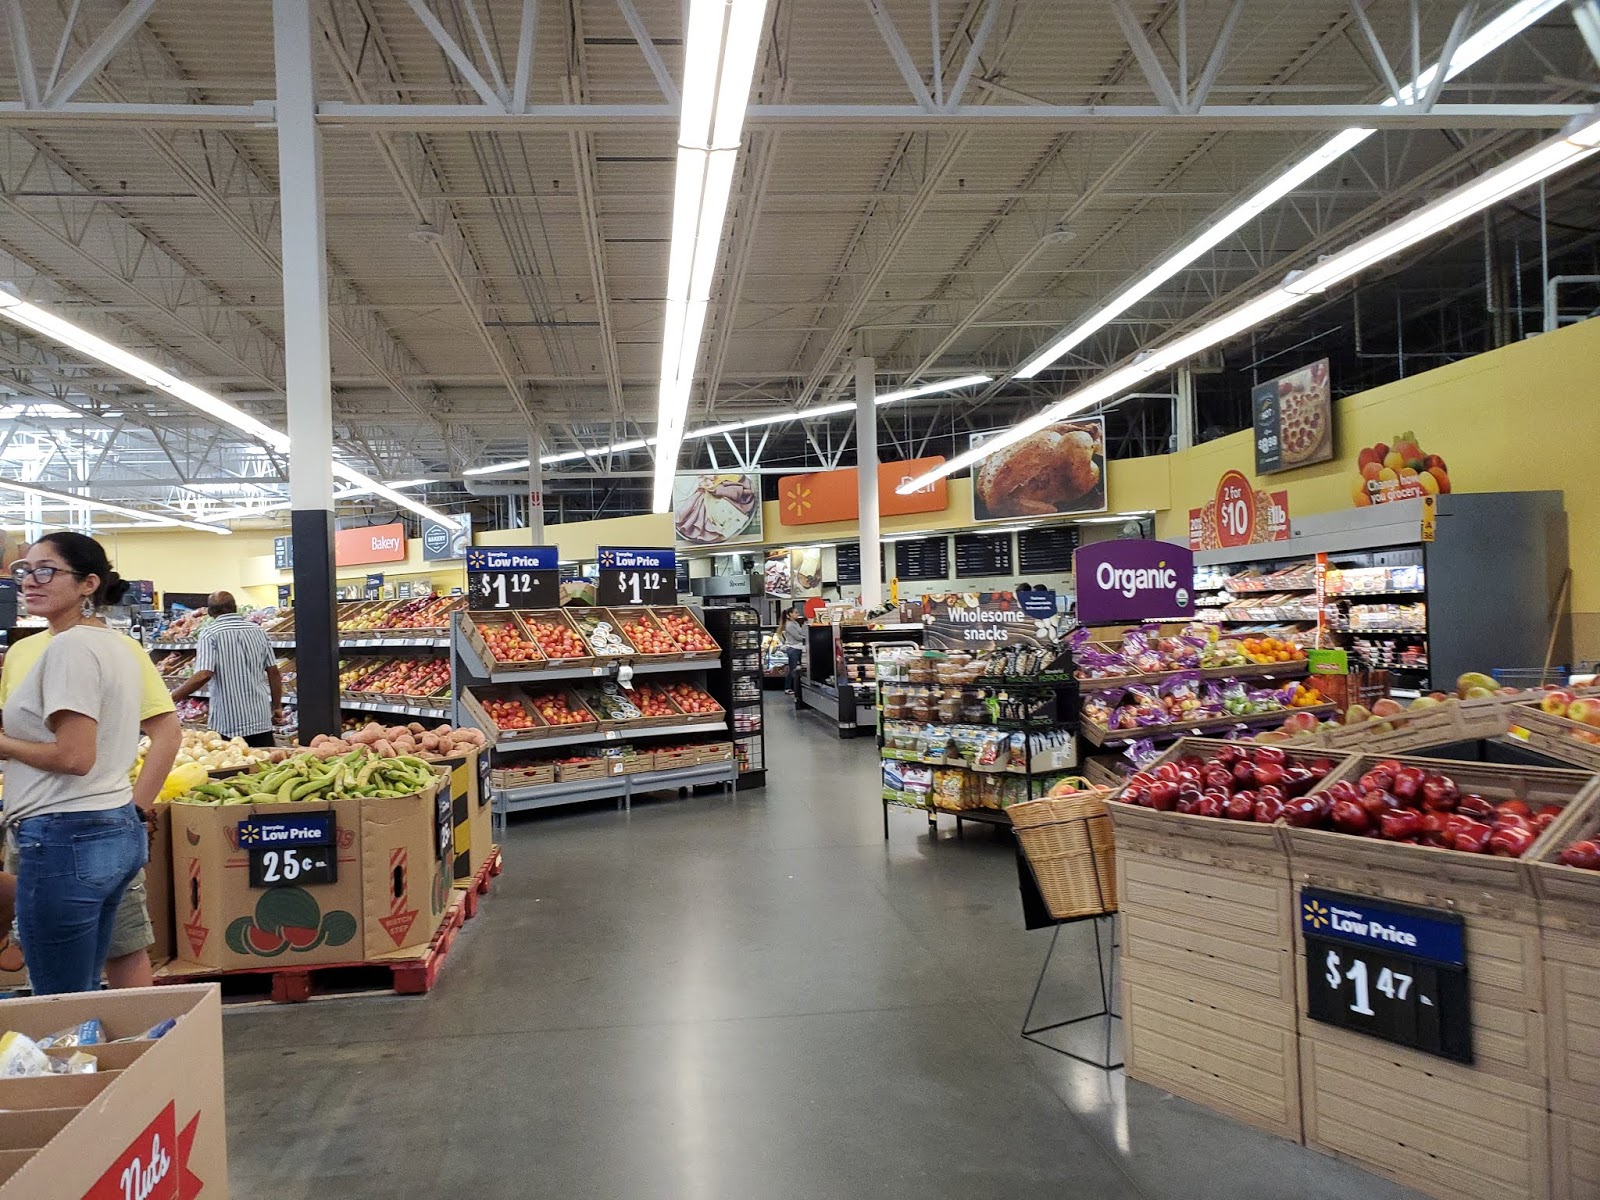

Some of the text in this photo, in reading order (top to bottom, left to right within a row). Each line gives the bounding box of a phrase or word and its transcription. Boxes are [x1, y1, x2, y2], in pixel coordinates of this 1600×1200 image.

[1223, 487, 1230, 501] 2
[1387, 487, 1423, 503] grocery.
[1221, 499, 1248, 536] $10
[371, 535, 400, 552] Bakery
[488, 556, 539, 567] Low Price
[616, 556, 660, 566] Low Price
[1096, 561, 1177, 598] Organic
[947, 607, 1025, 623] Wholesome
[964, 625, 1008, 641] snacks
[262, 828, 322, 841] Low Price
[1331, 914, 1417, 947] Low Price
[119, 1133, 171, 1200] Nuts
